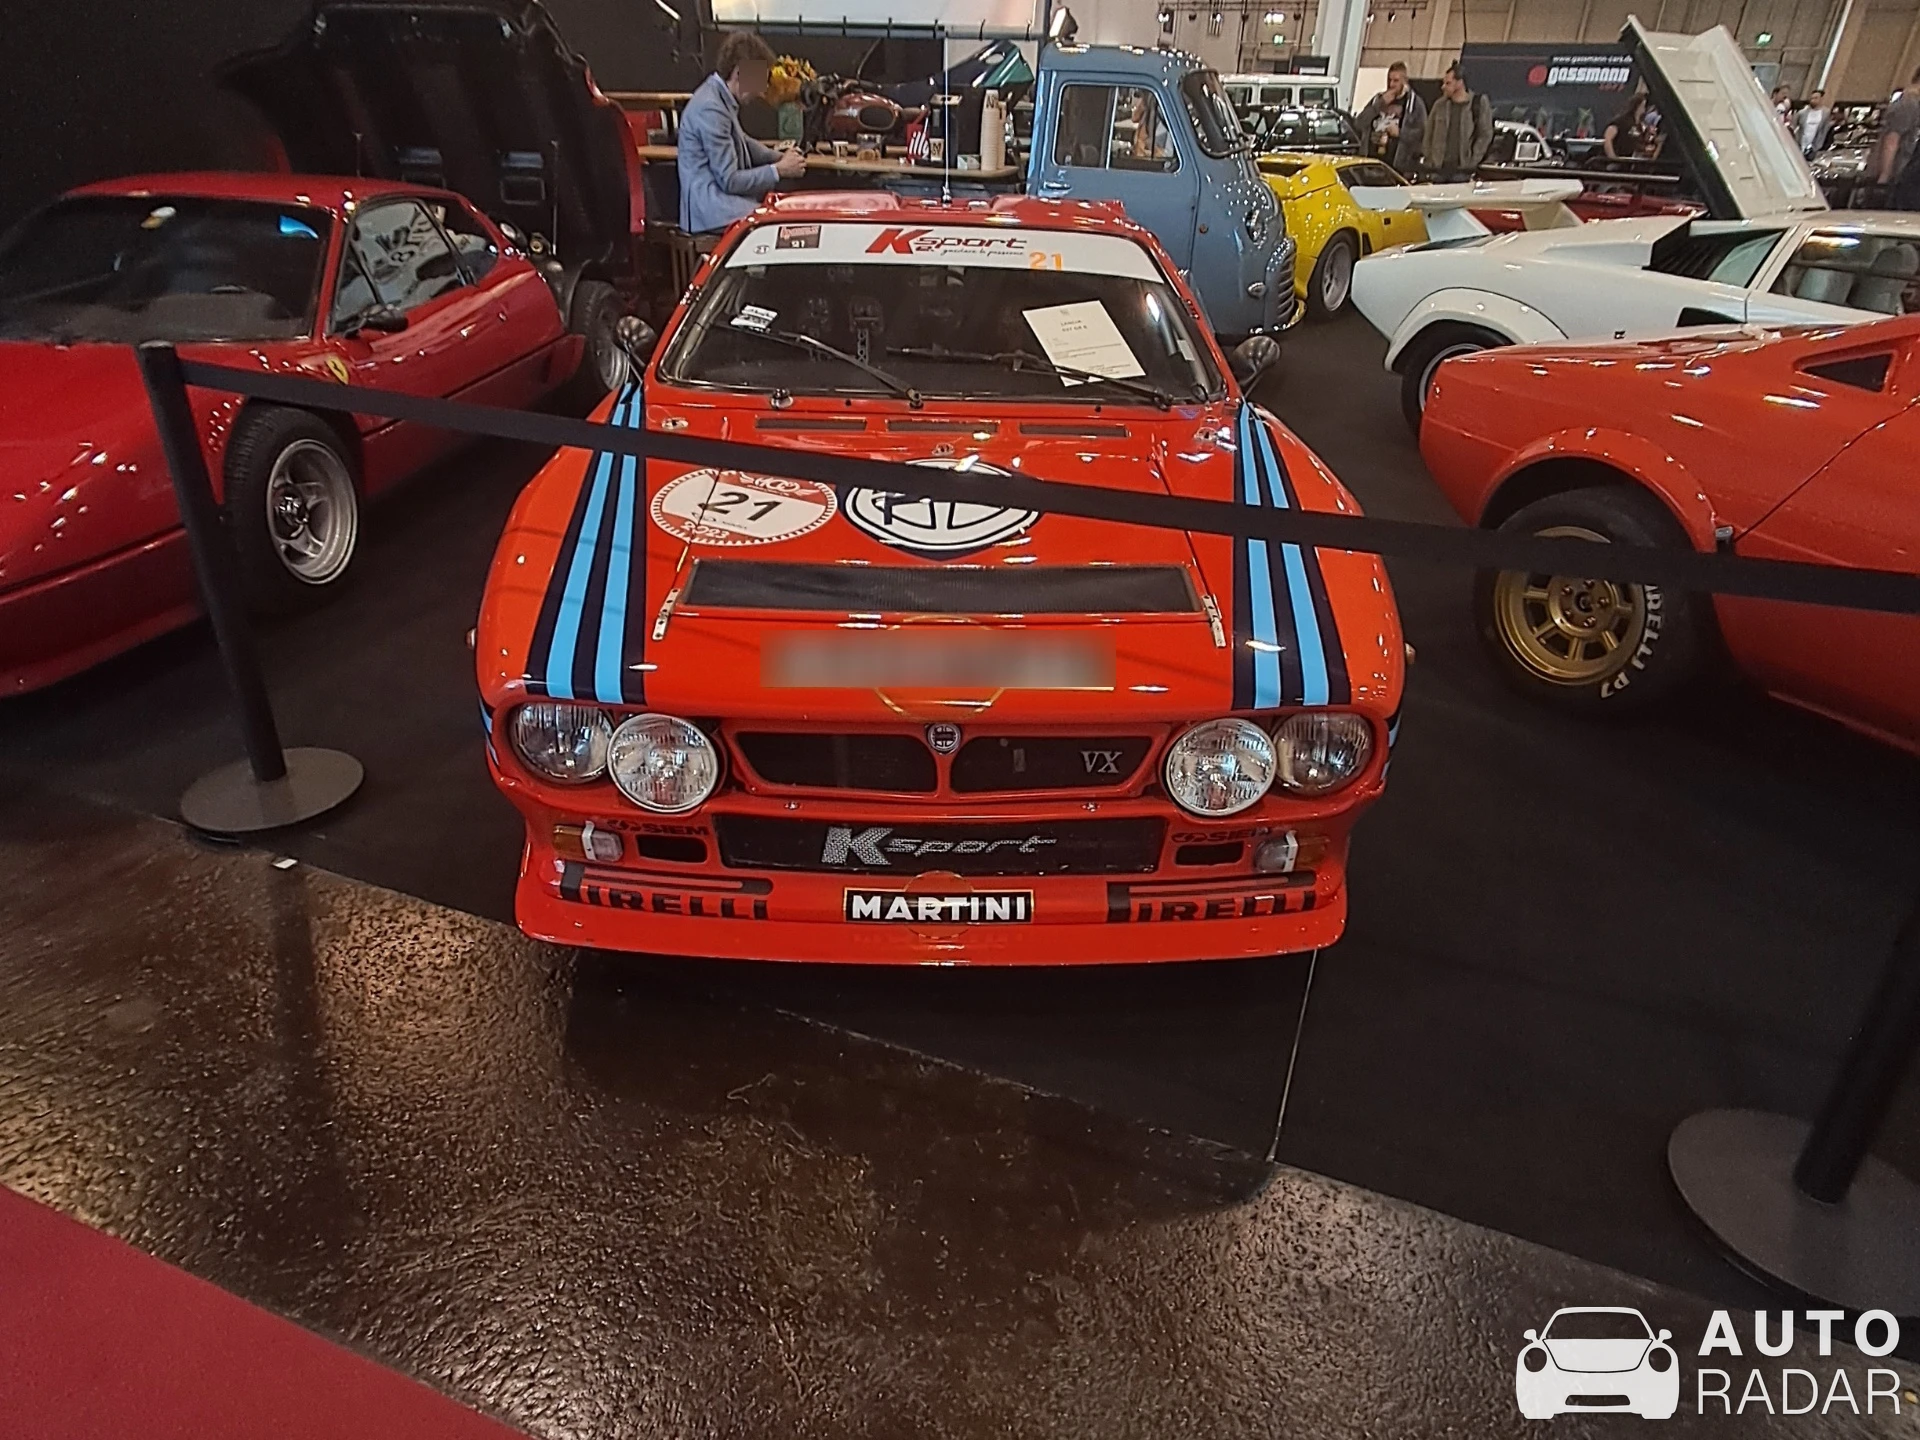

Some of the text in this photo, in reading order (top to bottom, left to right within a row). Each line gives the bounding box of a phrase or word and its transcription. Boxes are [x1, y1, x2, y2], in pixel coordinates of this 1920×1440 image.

[1029, 252, 1063, 271] 21
[698, 491, 782, 521] 21
[680, 520, 730, 539] 2023
[1601, 671, 1630, 698] P7
[1081, 751, 1123, 774] VX
[852, 895, 1026, 921] MARTINI
